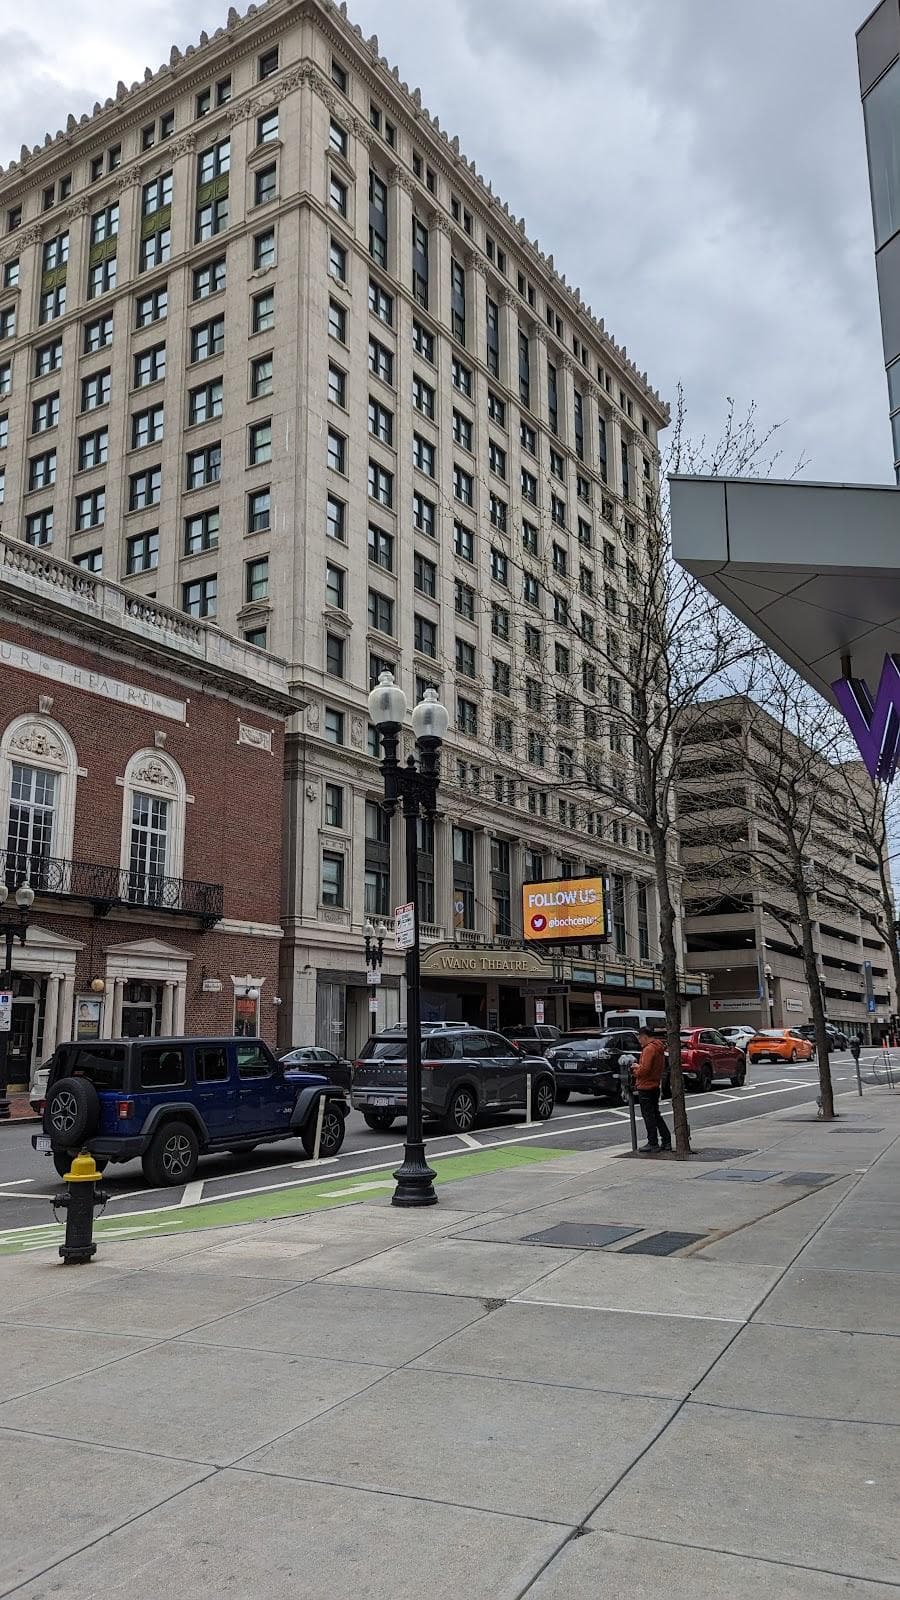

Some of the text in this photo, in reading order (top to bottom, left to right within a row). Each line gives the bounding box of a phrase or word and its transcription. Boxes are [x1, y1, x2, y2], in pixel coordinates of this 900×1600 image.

[60, 665, 149, 706] THEATRE
[528, 889, 597, 908] FOLLOW US
